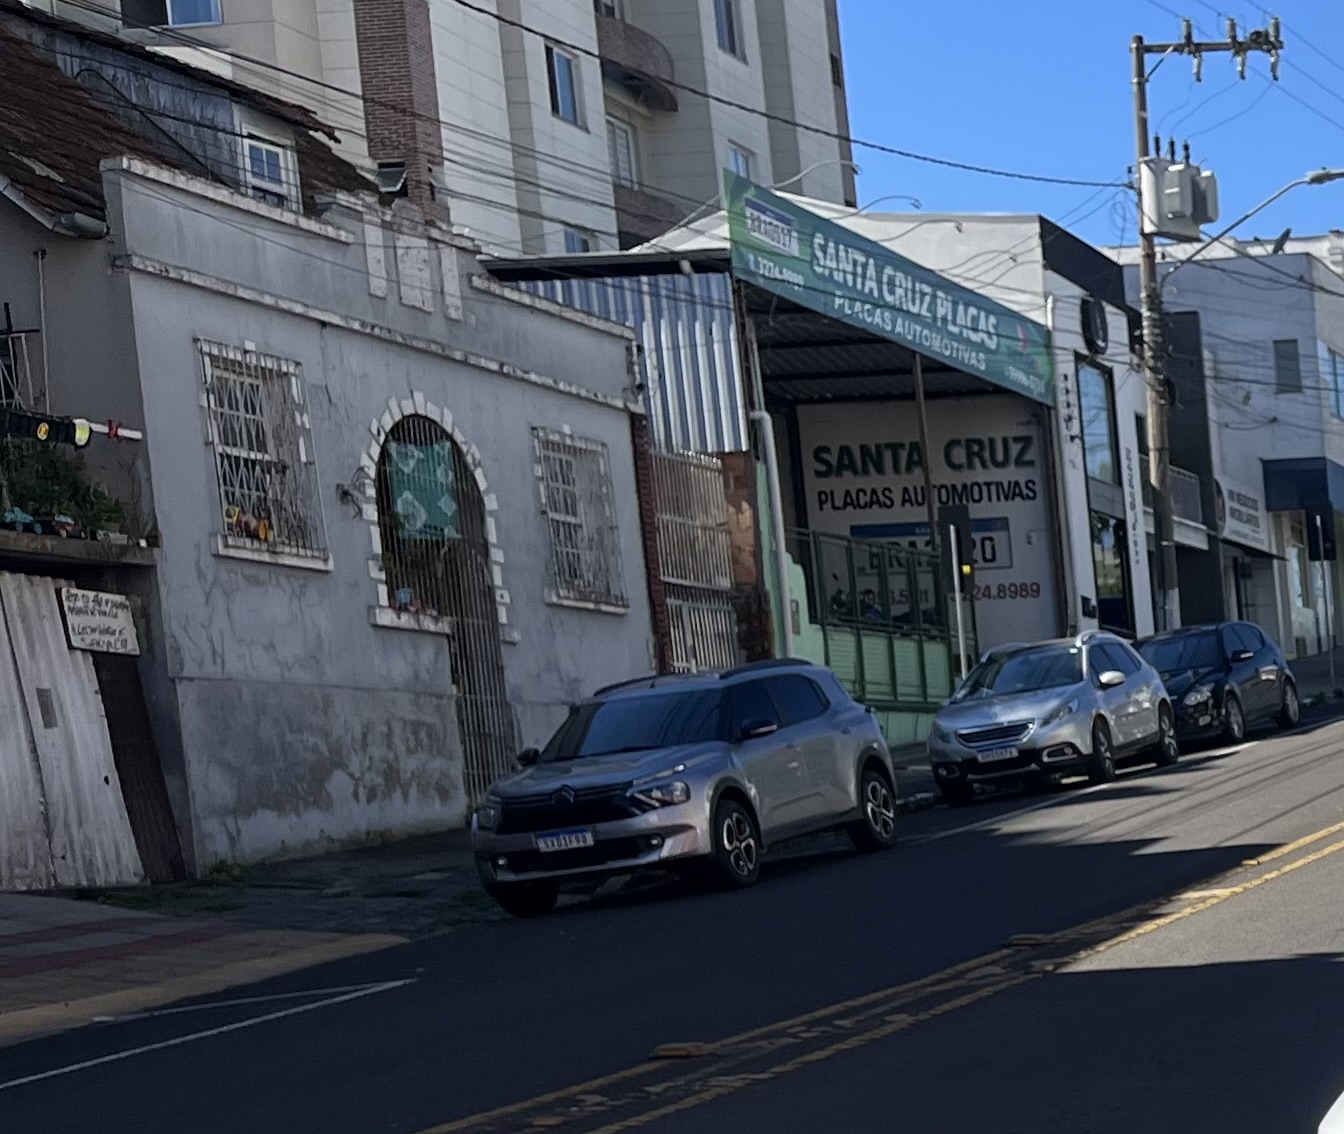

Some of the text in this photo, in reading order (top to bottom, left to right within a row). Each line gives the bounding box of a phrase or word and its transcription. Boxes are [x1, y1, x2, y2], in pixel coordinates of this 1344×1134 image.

[812, 232, 998, 350] SANTA CRUZ PLACAS
[834, 289, 987, 371] PLACAS AUTOMOTIVAS
[812, 435, 1036, 479] SANTA CRUZ
[817, 486, 895, 512] PLACAS
